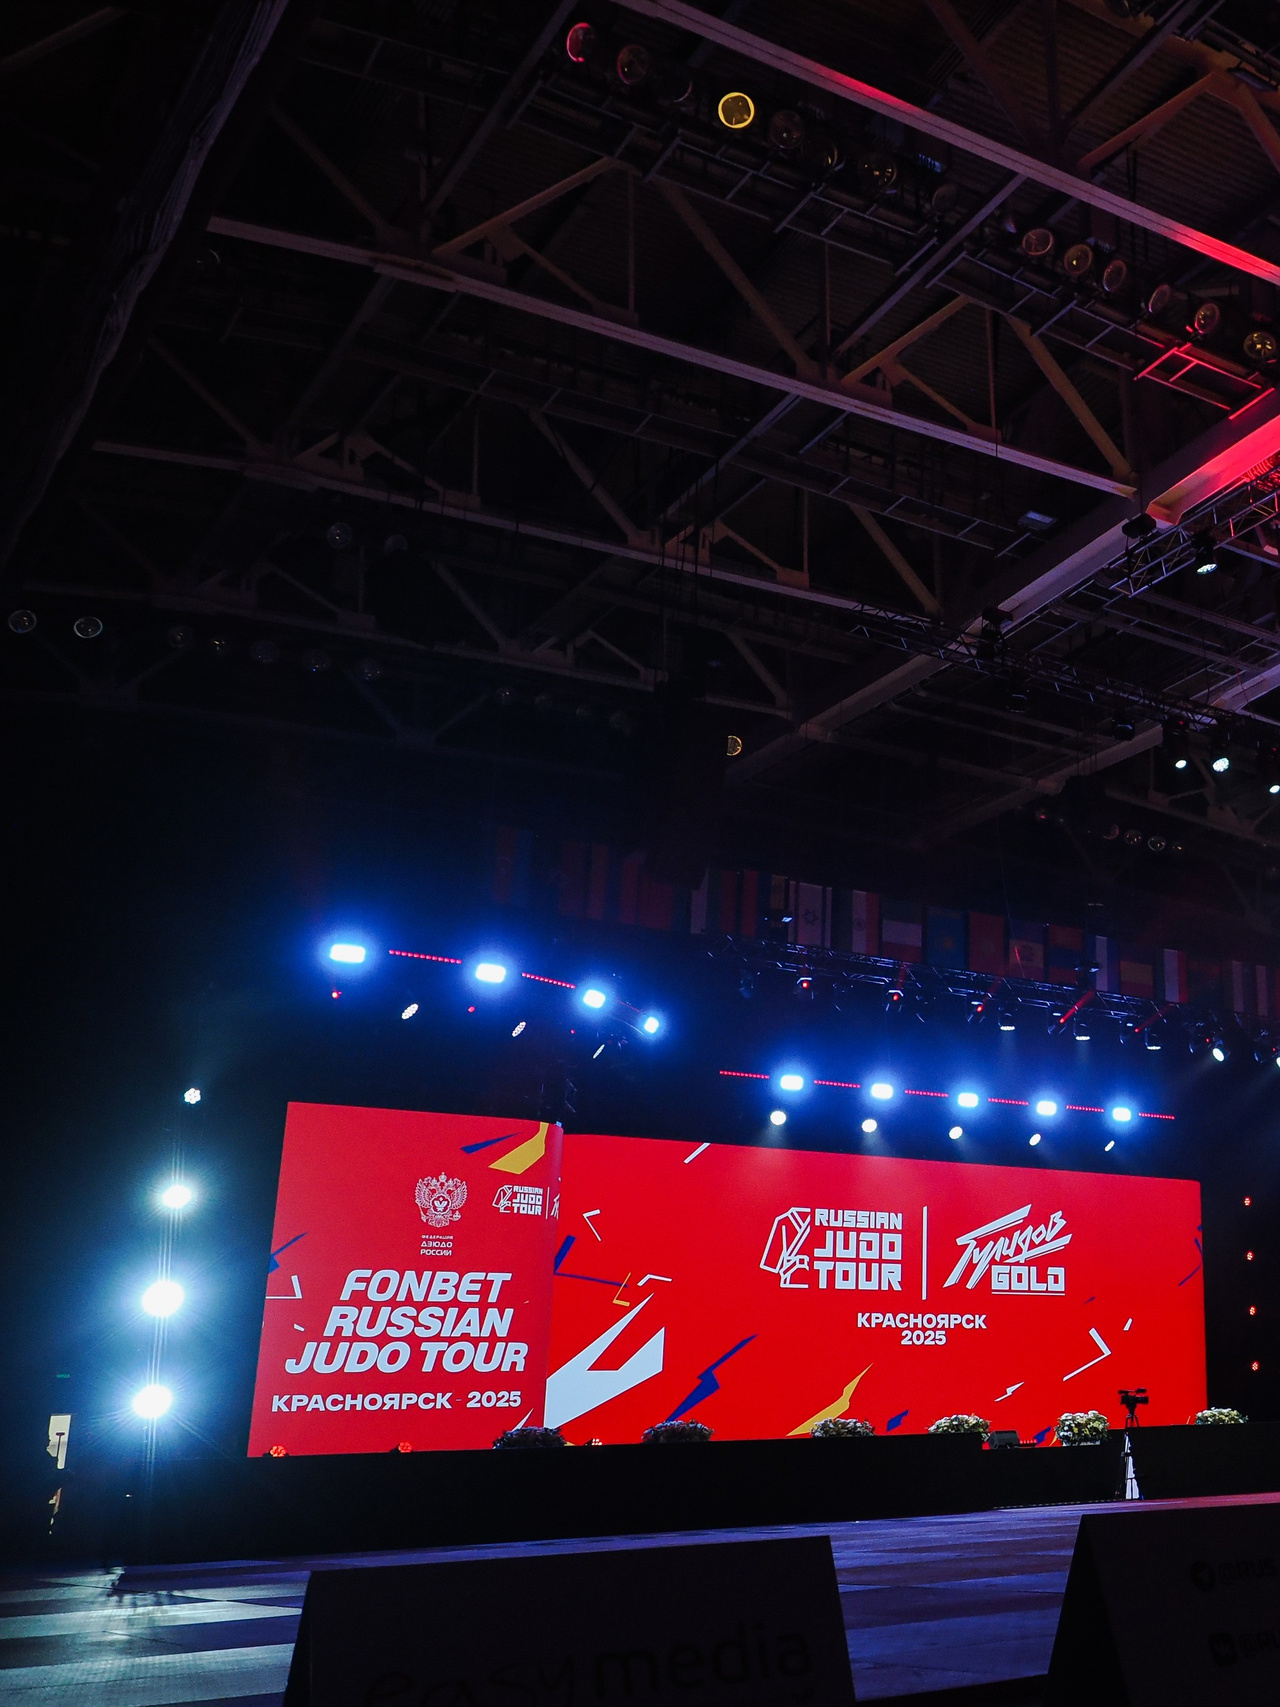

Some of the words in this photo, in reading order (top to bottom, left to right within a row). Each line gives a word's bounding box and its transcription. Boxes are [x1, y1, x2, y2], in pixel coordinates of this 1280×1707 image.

[512, 1193, 543, 1205] JUDO
[512, 1204, 542, 1215] TOUR
[814, 1208, 903, 1231] RUSSIAN
[420, 1249, 452, 1257] РОССИИ
[813, 1231, 903, 1261] JUDO
[340, 1269, 512, 1303] FONBET
[813, 1260, 903, 1291] TOUR
[991, 1265, 1066, 1292] GOLD
[323, 1306, 514, 1338] RUSSIAN
[857, 1313, 988, 1330] КРАСНОЯРСК
[900, 1330, 947, 1345] 2025
[285, 1341, 411, 1374] JUDO
[420, 1341, 529, 1372] TOUR
[271, 1393, 453, 1412] КРАСНОЯРСК
[466, 1390, 522, 1408] 2025
